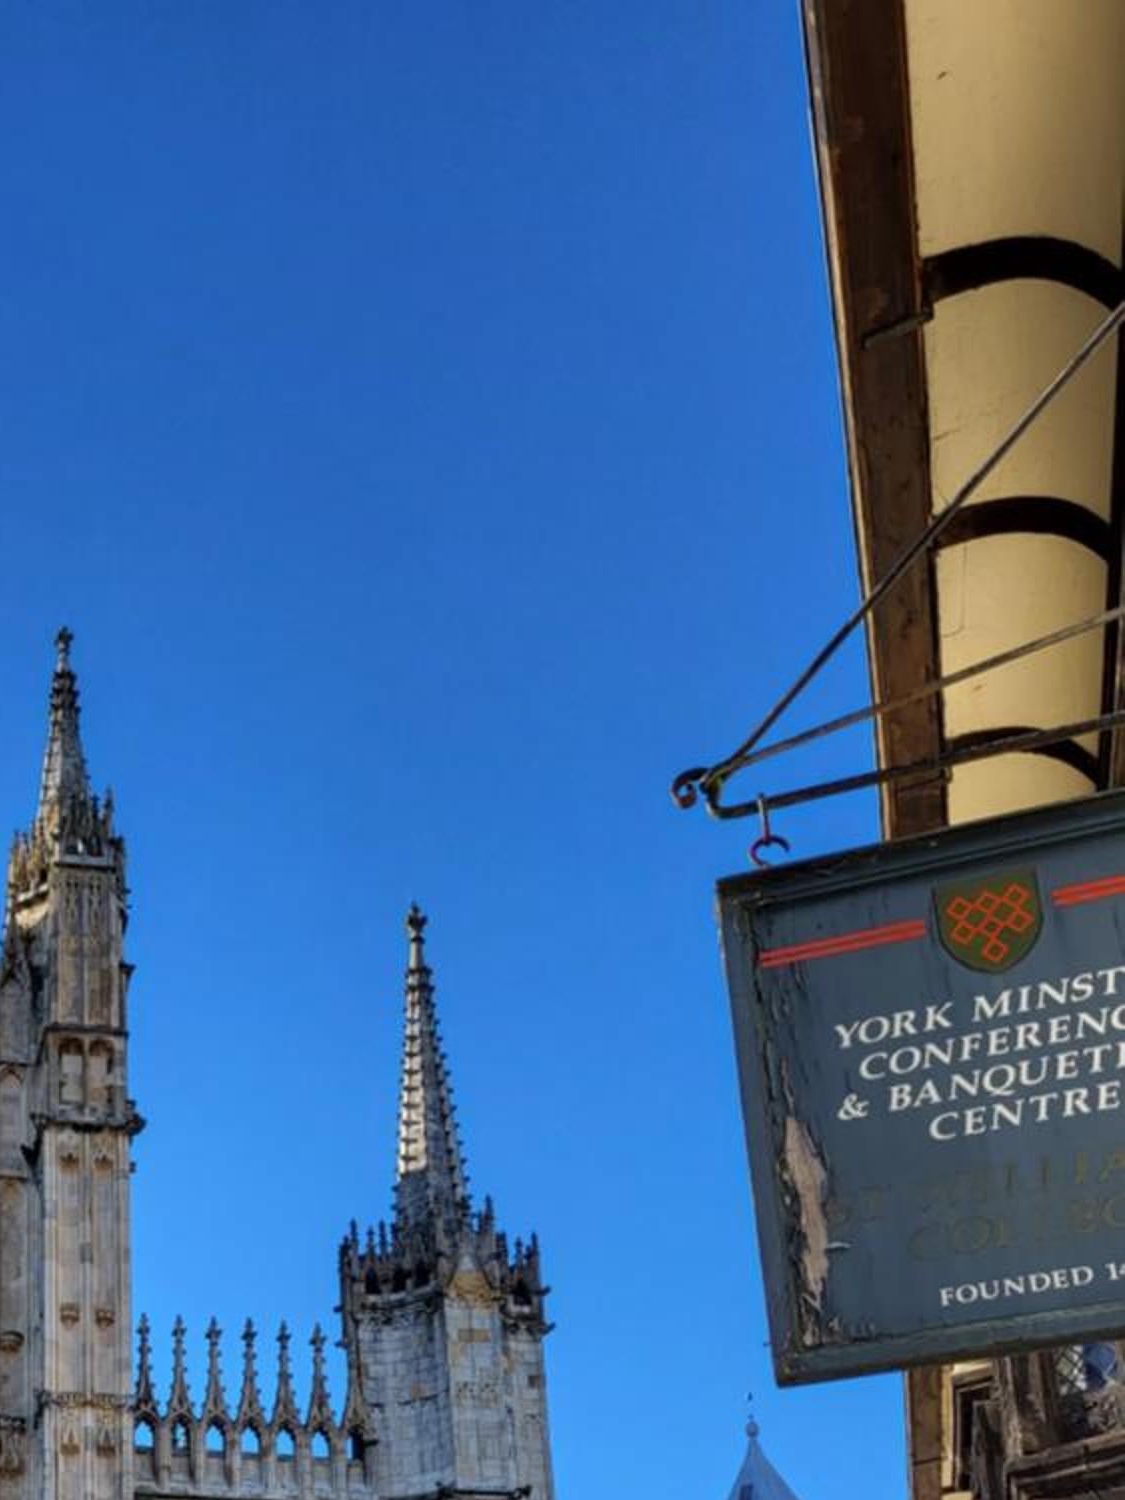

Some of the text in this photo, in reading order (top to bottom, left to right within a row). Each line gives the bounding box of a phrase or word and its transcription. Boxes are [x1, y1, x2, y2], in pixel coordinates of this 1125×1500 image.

[834, 965, 1125, 1048] YORK MINST
[837, 1093, 869, 1120] &
[929, 1080, 1121, 1140] CENTRE
[939, 1265, 1094, 1306] FOUNDED
